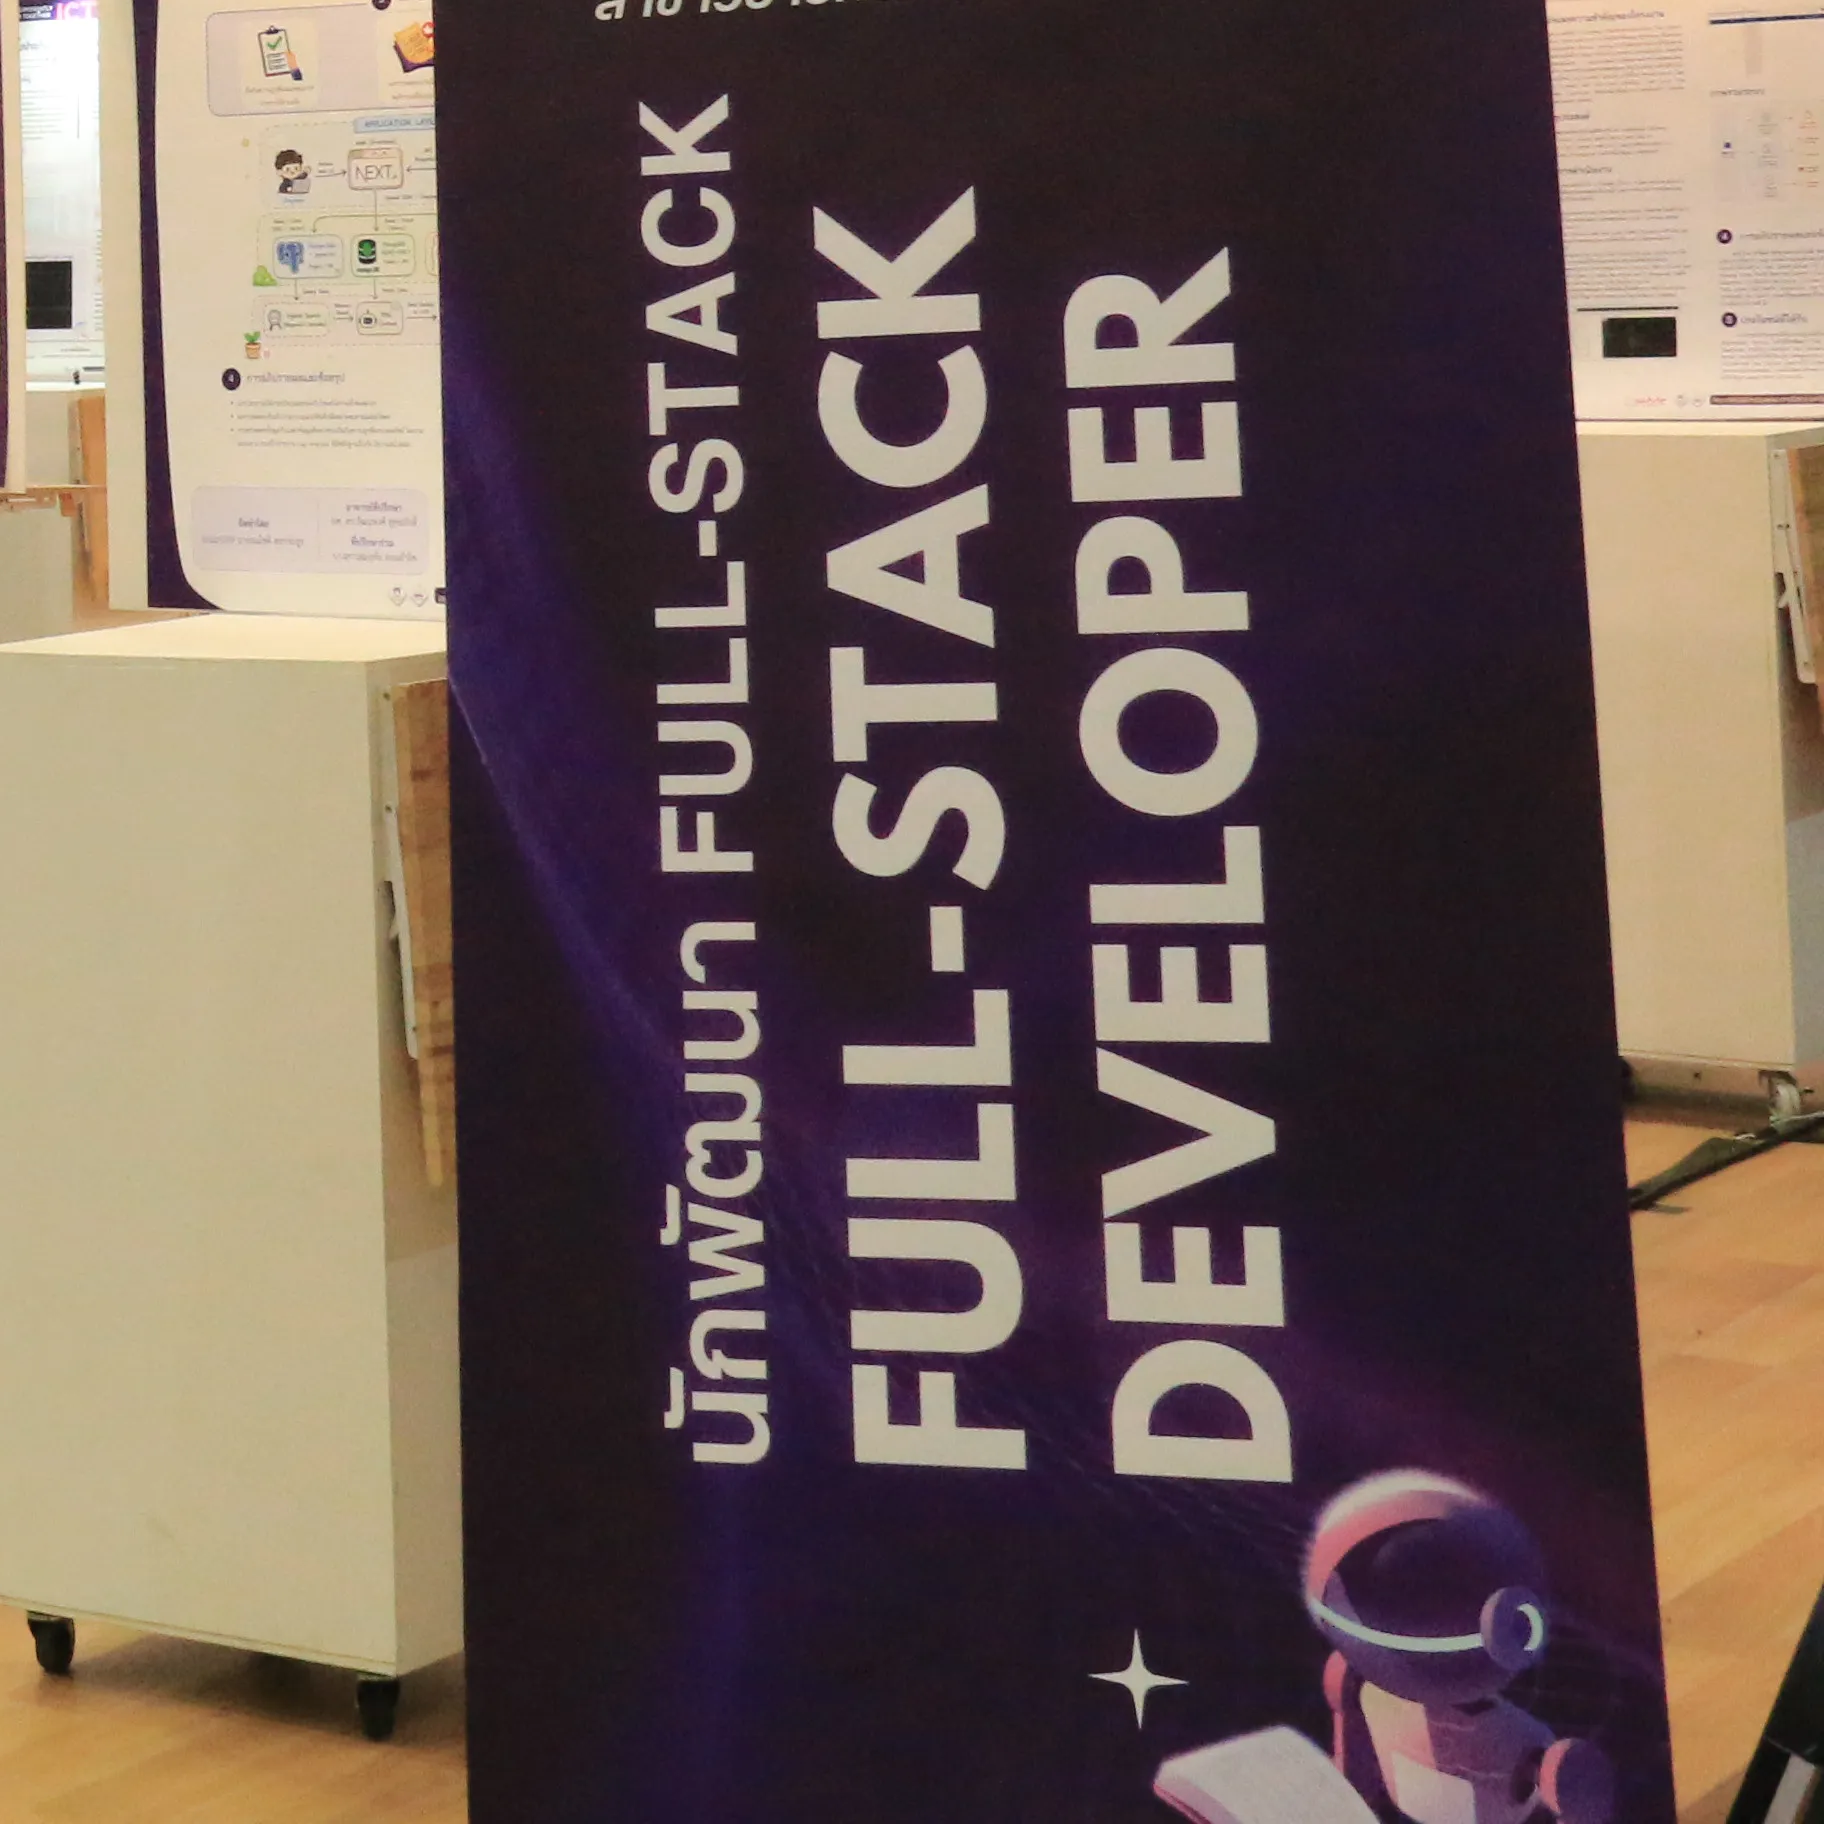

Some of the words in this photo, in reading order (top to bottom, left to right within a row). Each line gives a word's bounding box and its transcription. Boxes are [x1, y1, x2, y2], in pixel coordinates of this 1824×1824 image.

[638, 92, 756, 874] FULL-STACK
[812, 186, 1028, 1472] FULL-STACK
[1062, 246, 1294, 1484] DEVELOPER
[662, 919, 770, 1467] นักพัฒนา
